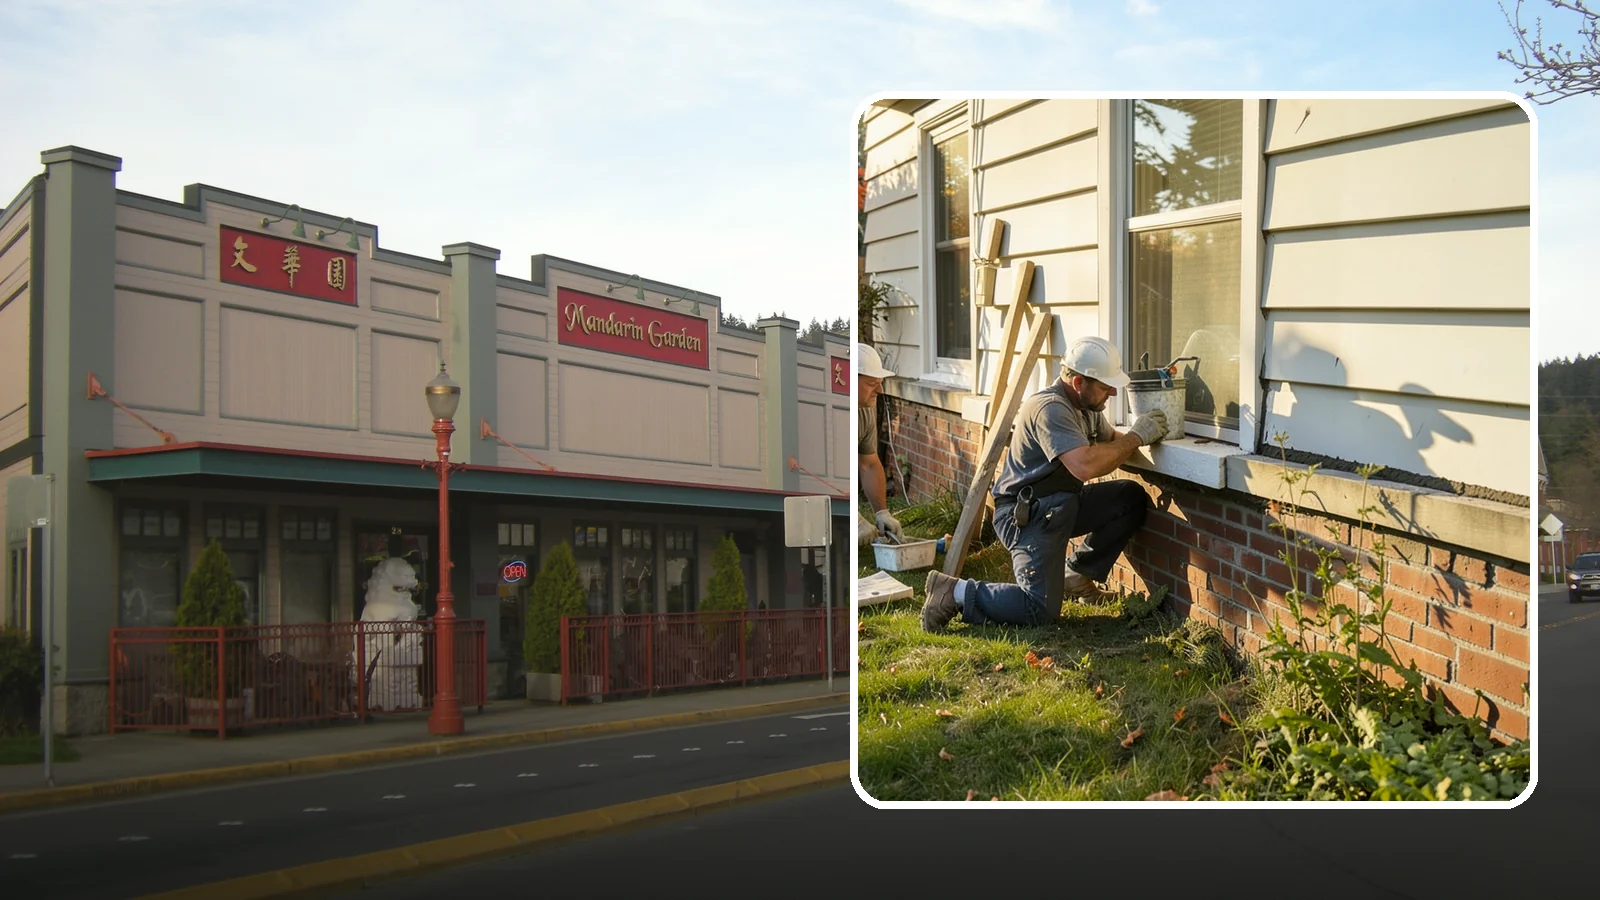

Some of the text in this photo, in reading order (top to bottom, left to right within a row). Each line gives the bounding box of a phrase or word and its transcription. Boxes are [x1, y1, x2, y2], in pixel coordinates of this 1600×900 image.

[231, 235, 346, 291] 文華園
[564, 302, 702, 352] Mandarin Garden
[503, 565, 527, 578] OPEN
